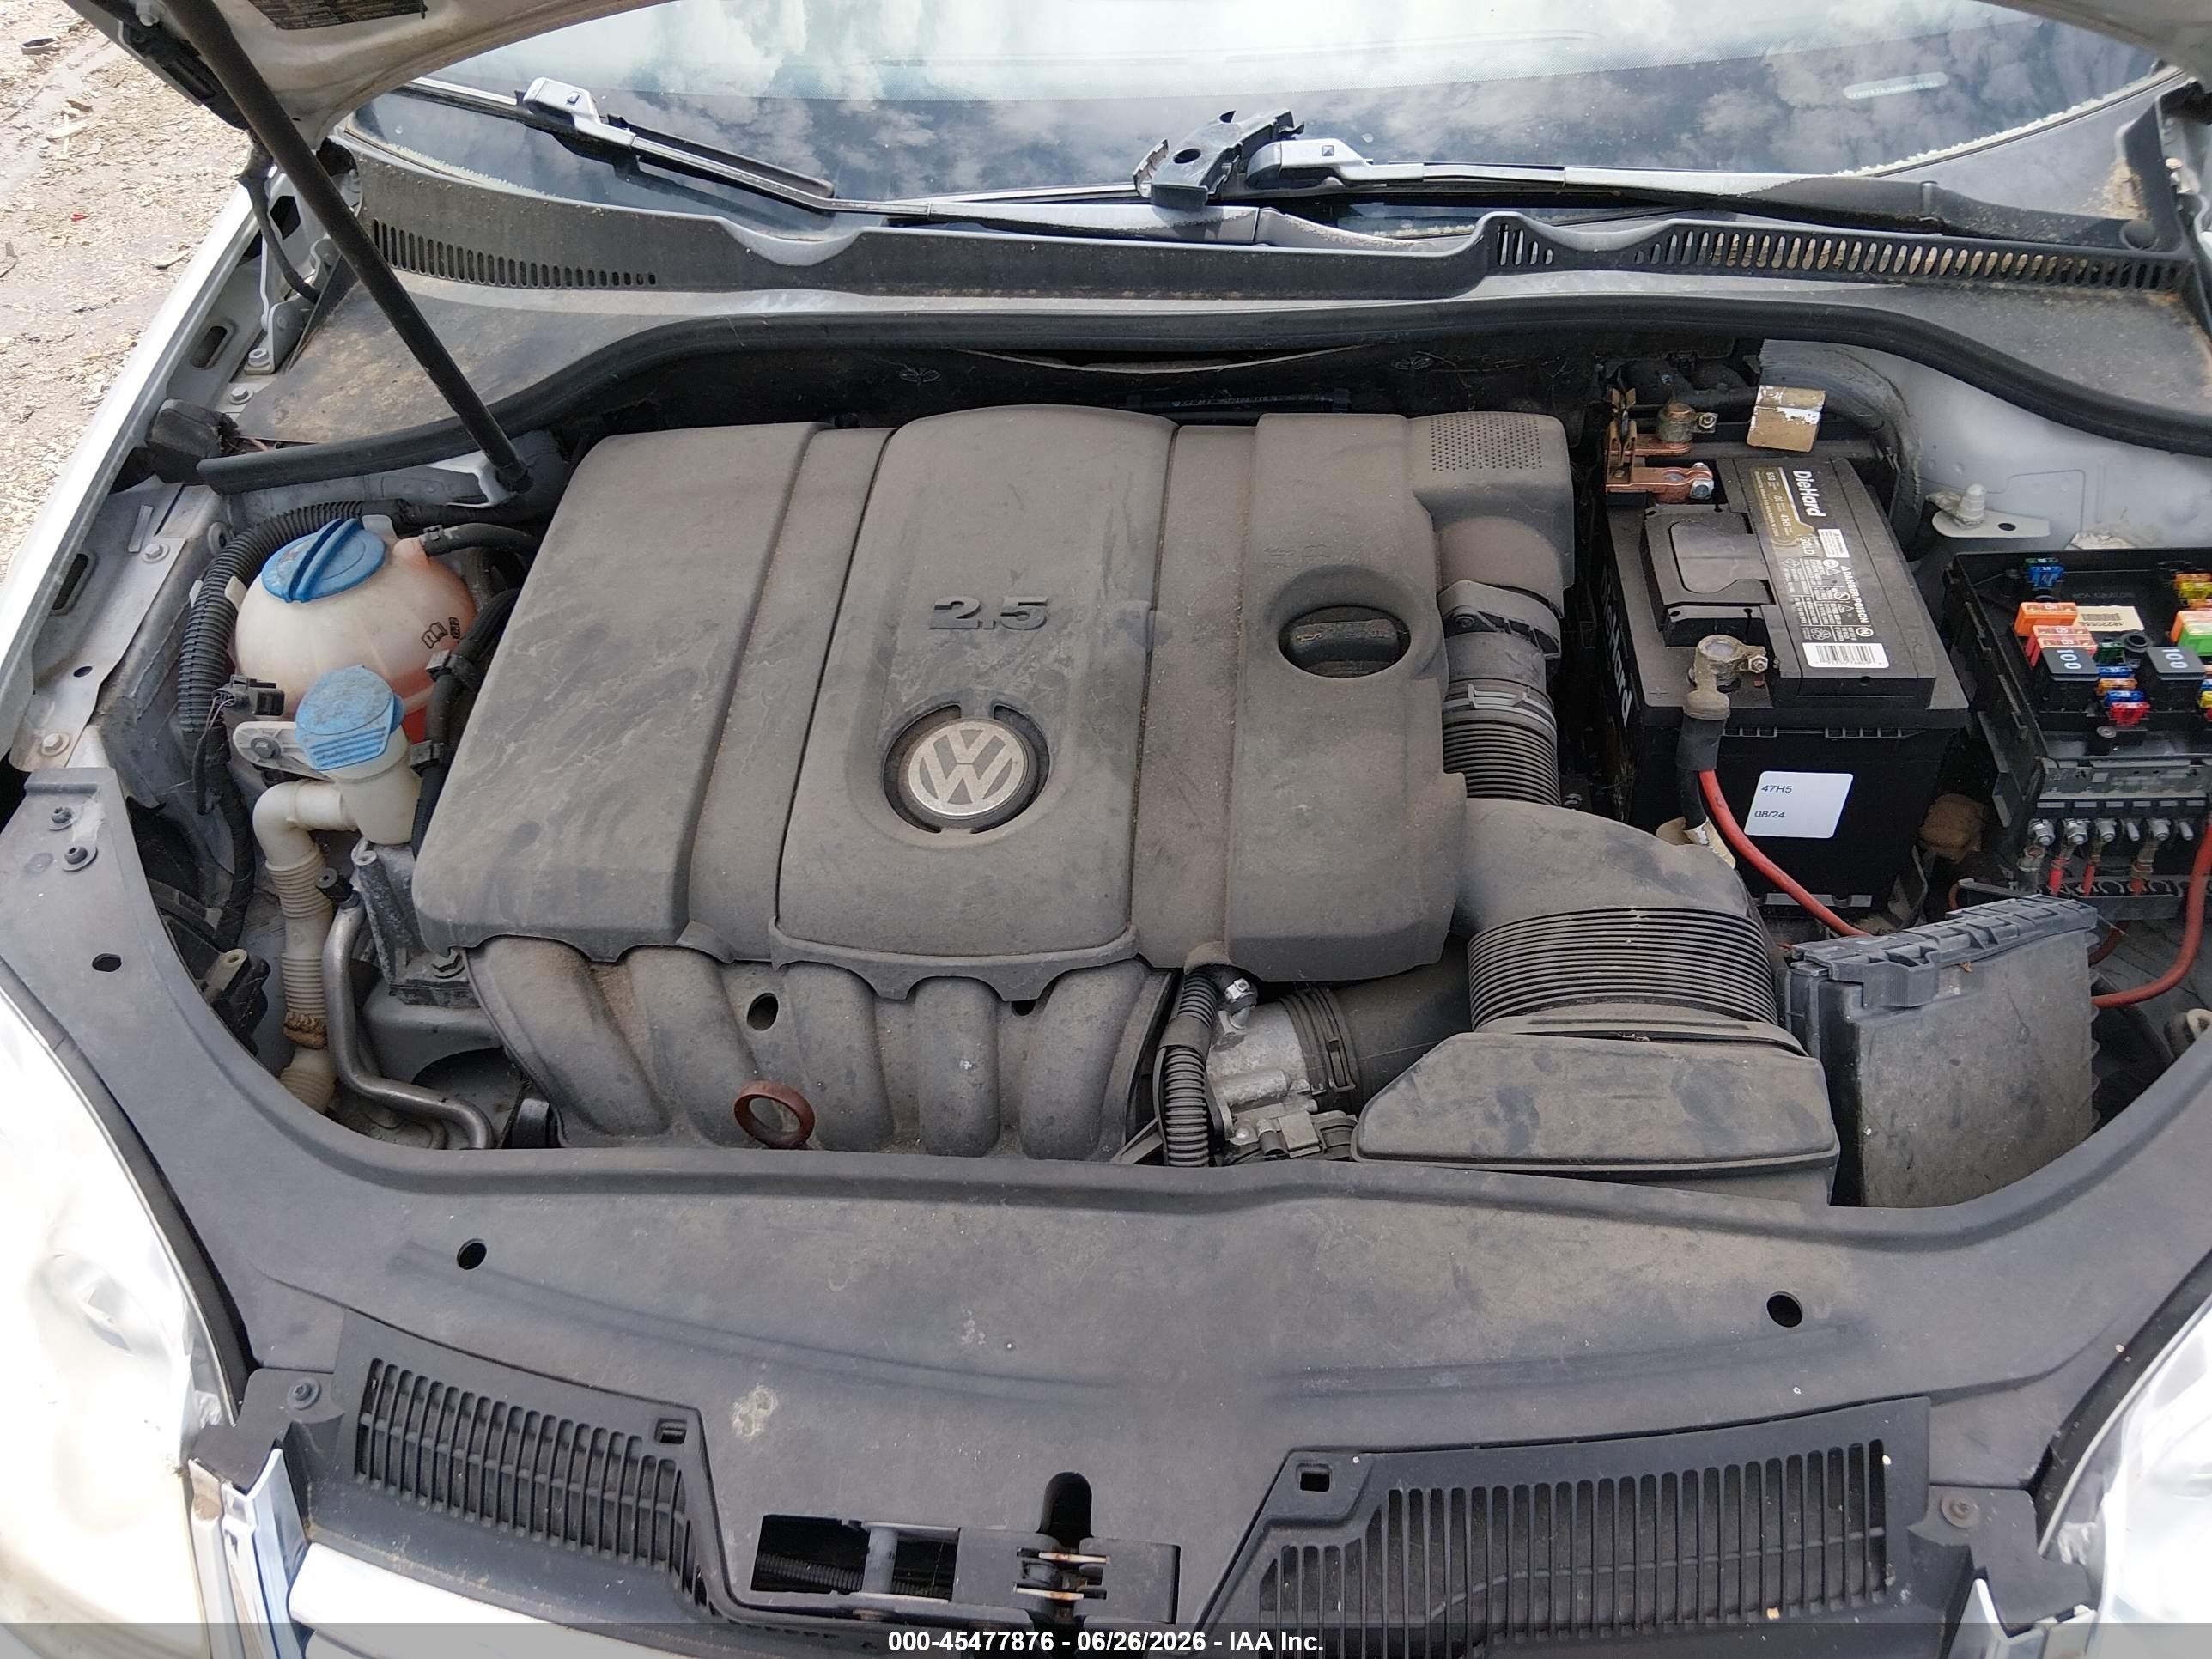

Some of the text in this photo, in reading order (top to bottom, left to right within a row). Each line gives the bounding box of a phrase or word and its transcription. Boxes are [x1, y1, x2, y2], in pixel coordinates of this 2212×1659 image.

[1792, 470, 1827, 517] DieHard
[1799, 537, 1814, 555] GOLD
[1844, 570, 1870, 623] DANGER/POISON
[929, 595, 1048, 631] 2.5
[2056, 649, 2082, 670] 100
[2161, 648, 2189, 669] 100
[1761, 784, 1793, 793] 47H5
[1753, 810, 1786, 819] 08/24
